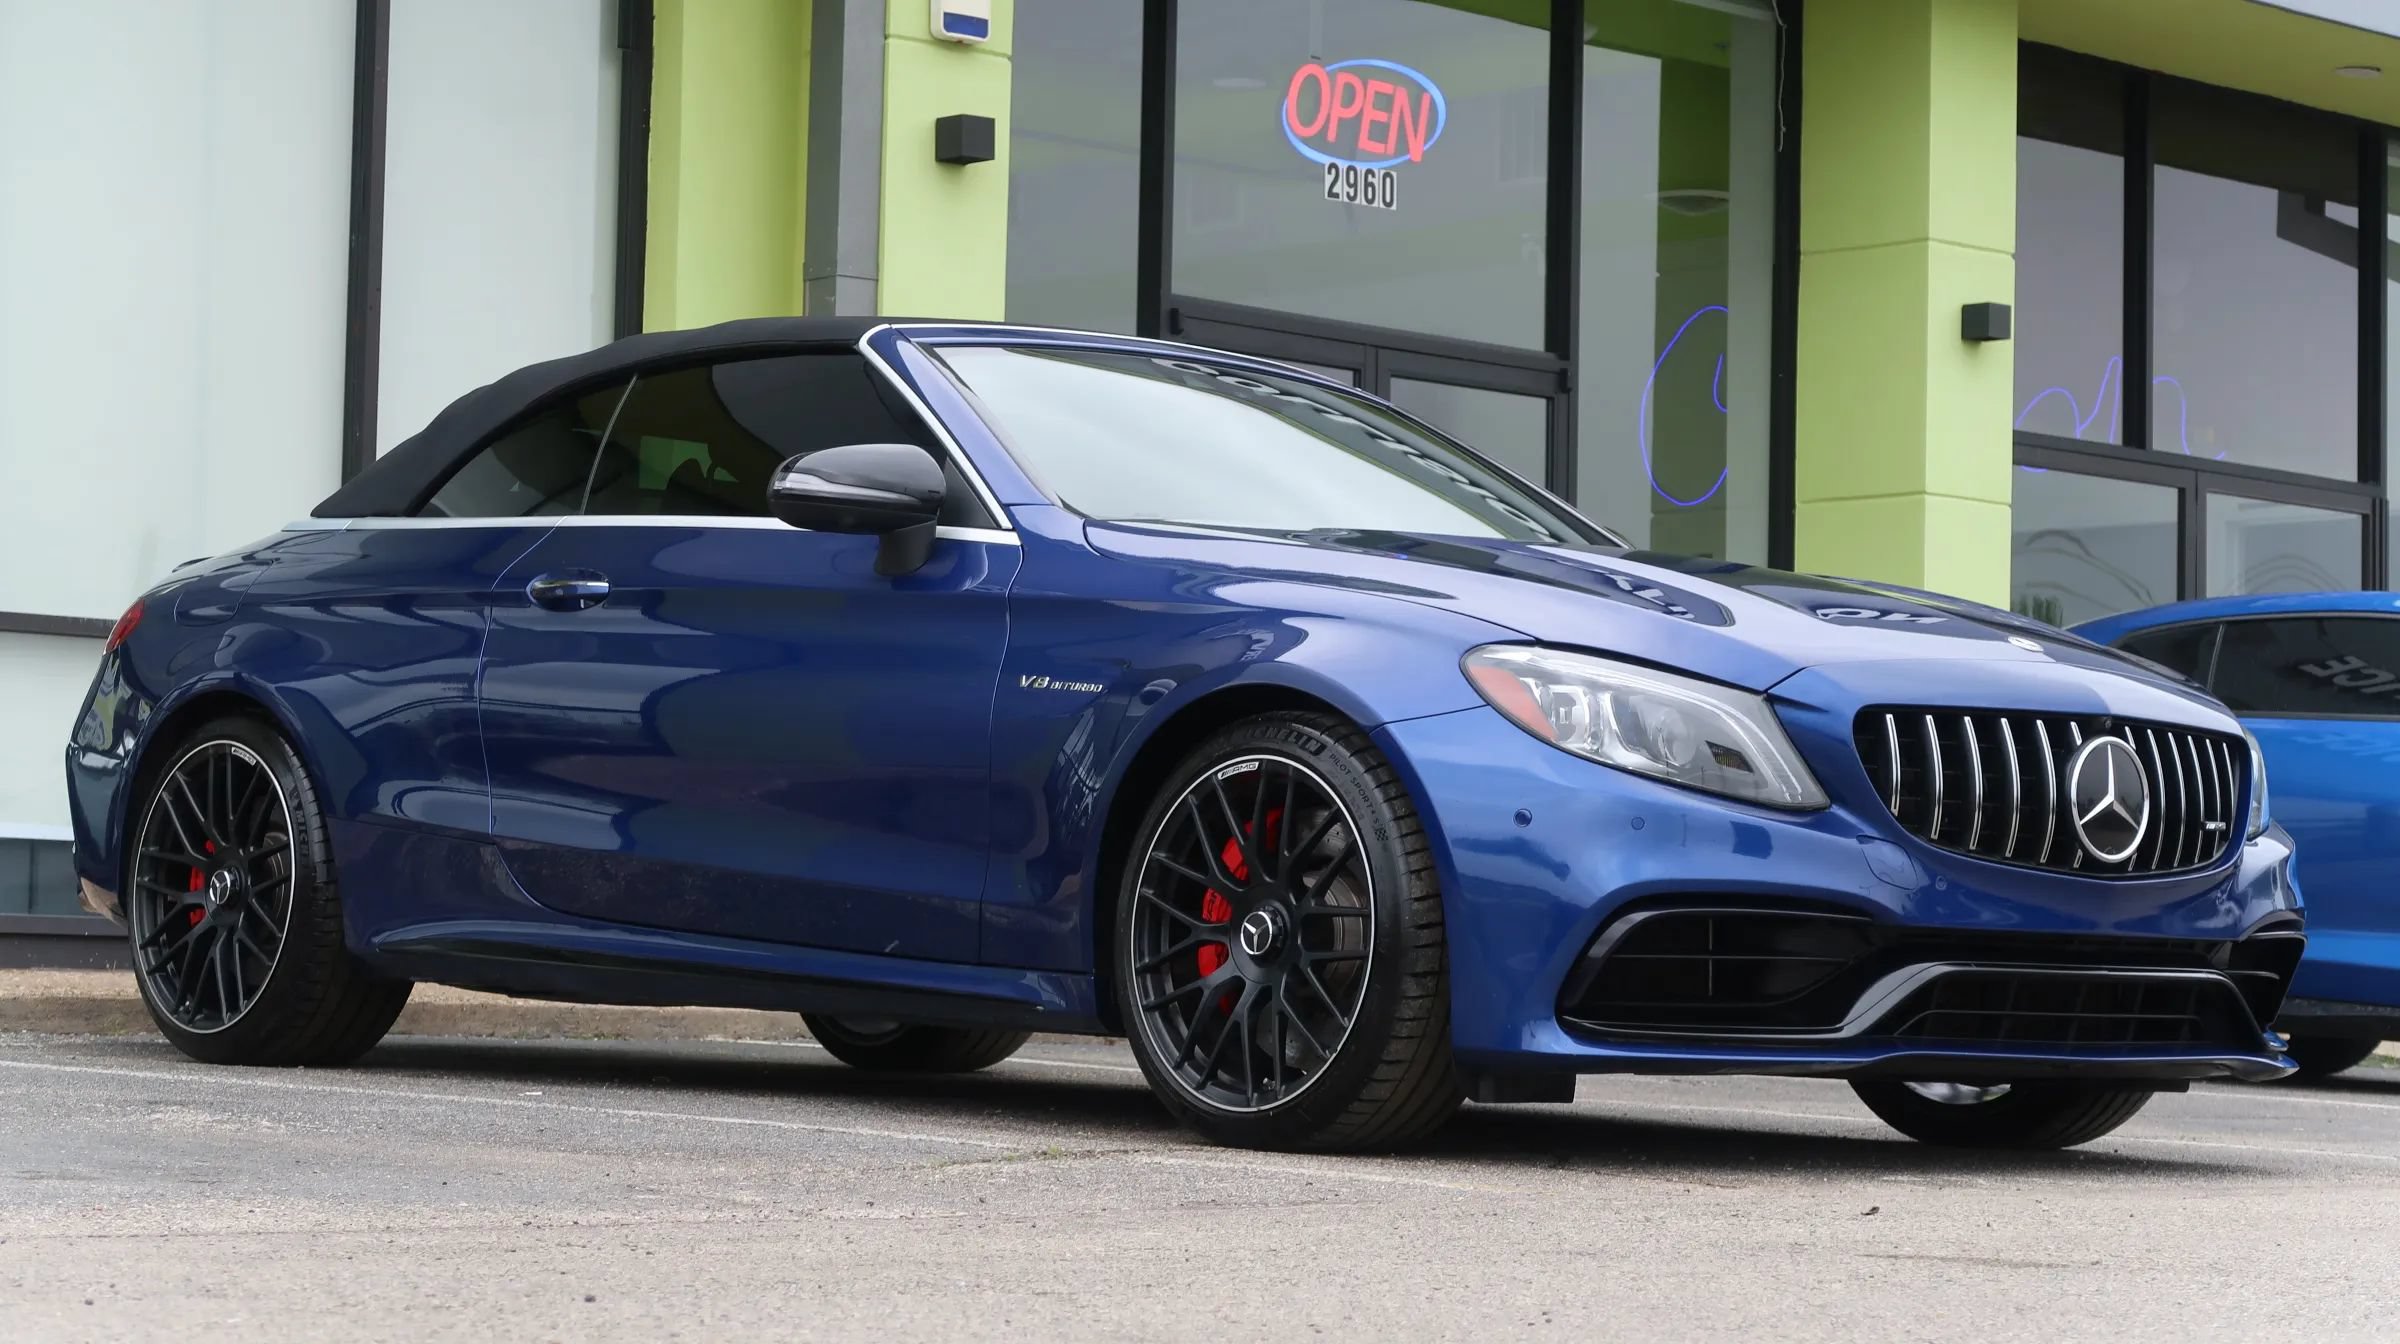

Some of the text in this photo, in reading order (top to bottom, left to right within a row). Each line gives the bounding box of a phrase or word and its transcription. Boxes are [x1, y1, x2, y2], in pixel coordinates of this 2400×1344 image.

[1287, 63, 1432, 163] OPEN
[1326, 162, 1396, 208] 2960
[1019, 674, 1104, 693] V8 BITURBO
[1330, 753, 1352, 776] PILOT
[1350, 776, 1373, 809] SPORT
